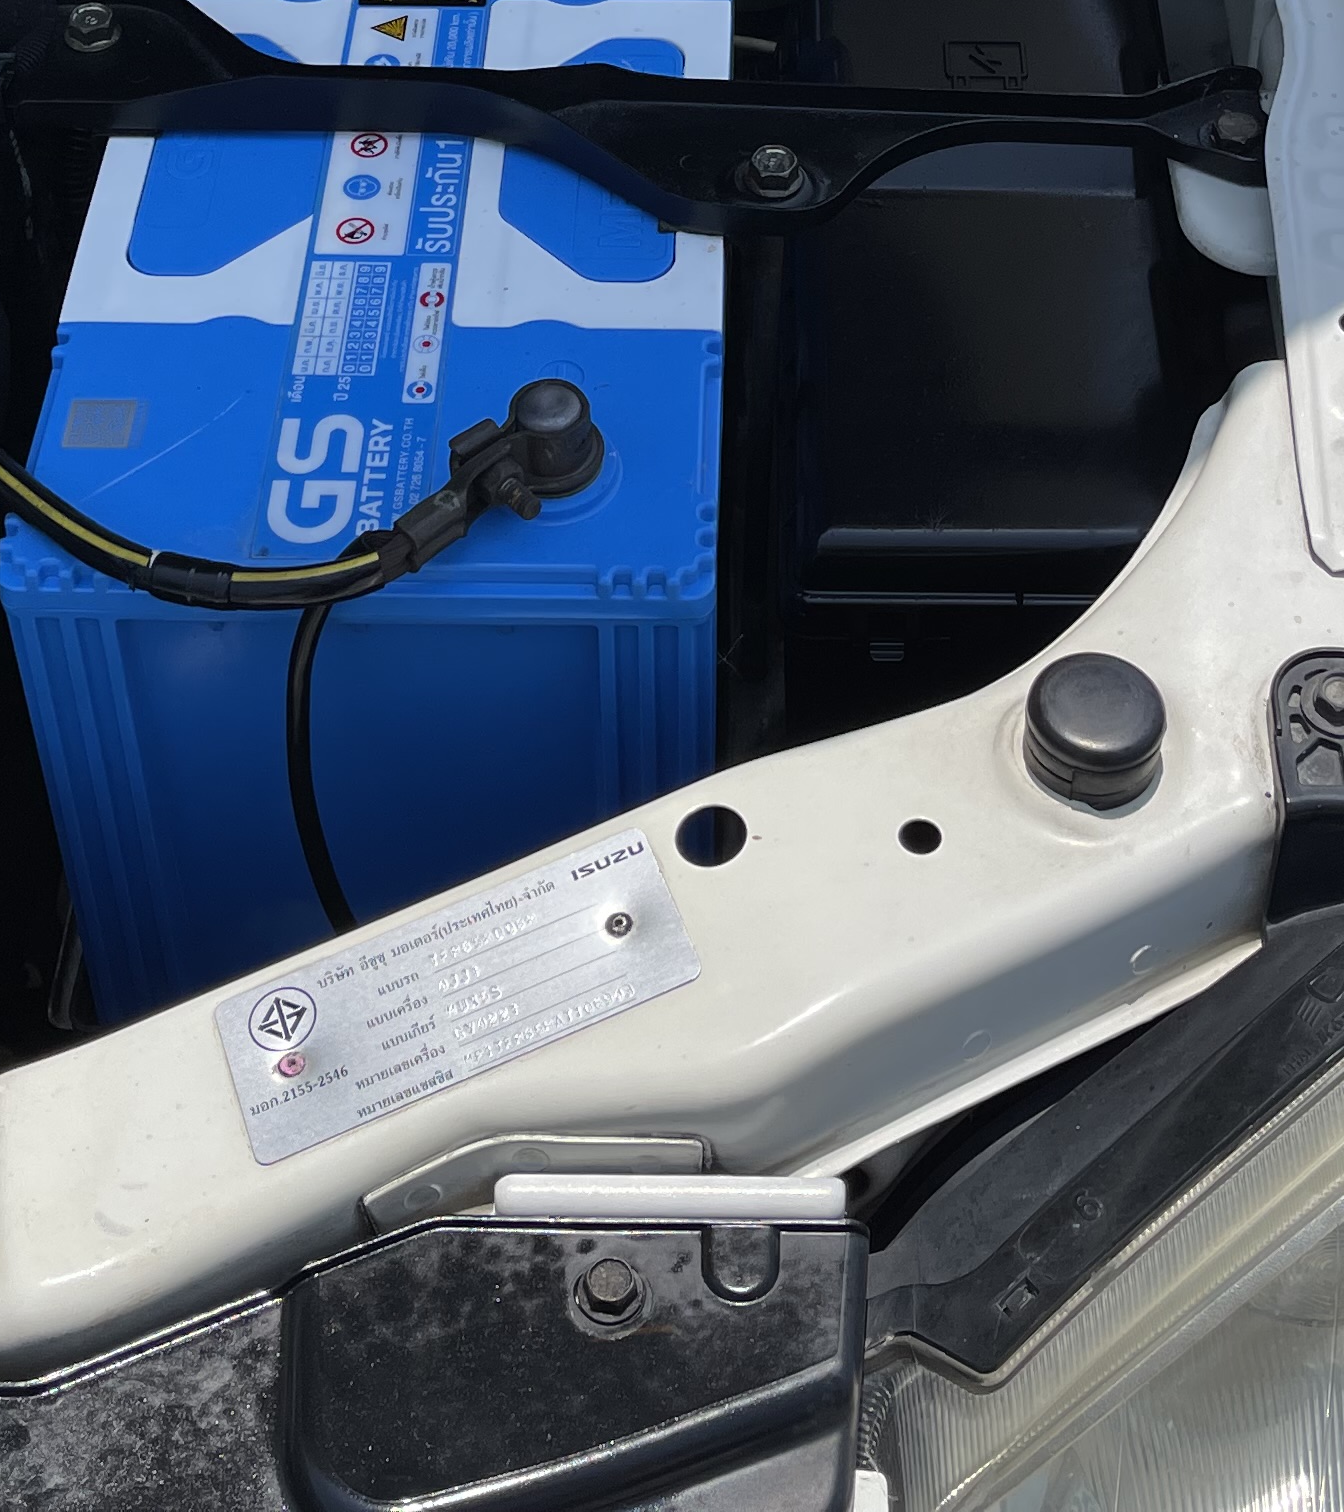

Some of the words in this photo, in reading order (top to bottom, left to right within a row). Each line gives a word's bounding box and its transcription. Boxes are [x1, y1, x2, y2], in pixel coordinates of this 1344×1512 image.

[415, 153, 464, 253] รับประกัน
[350, 320, 363, 328] 4
[348, 342, 359, 350] 2
[287, 376, 306, 403] เดือน
[337, 376, 351, 390] 25
[266, 414, 365, 544] GS
[356, 418, 394, 536] BATTERY
[570, 840, 646, 882] ISUZU
[316, 964, 356, 990] บริษัท
[358, 953, 389, 973] อีซูซุ
[377, 970, 420, 998] แบบรถ
[366, 992, 430, 1030] แบบเครื่อง
[381, 1014, 437, 1052] แบบเกียร์
[354, 1041, 447, 1092] หมายเลขเครื่อง
[248, 1063, 350, 1117] มอก.2155-2546
